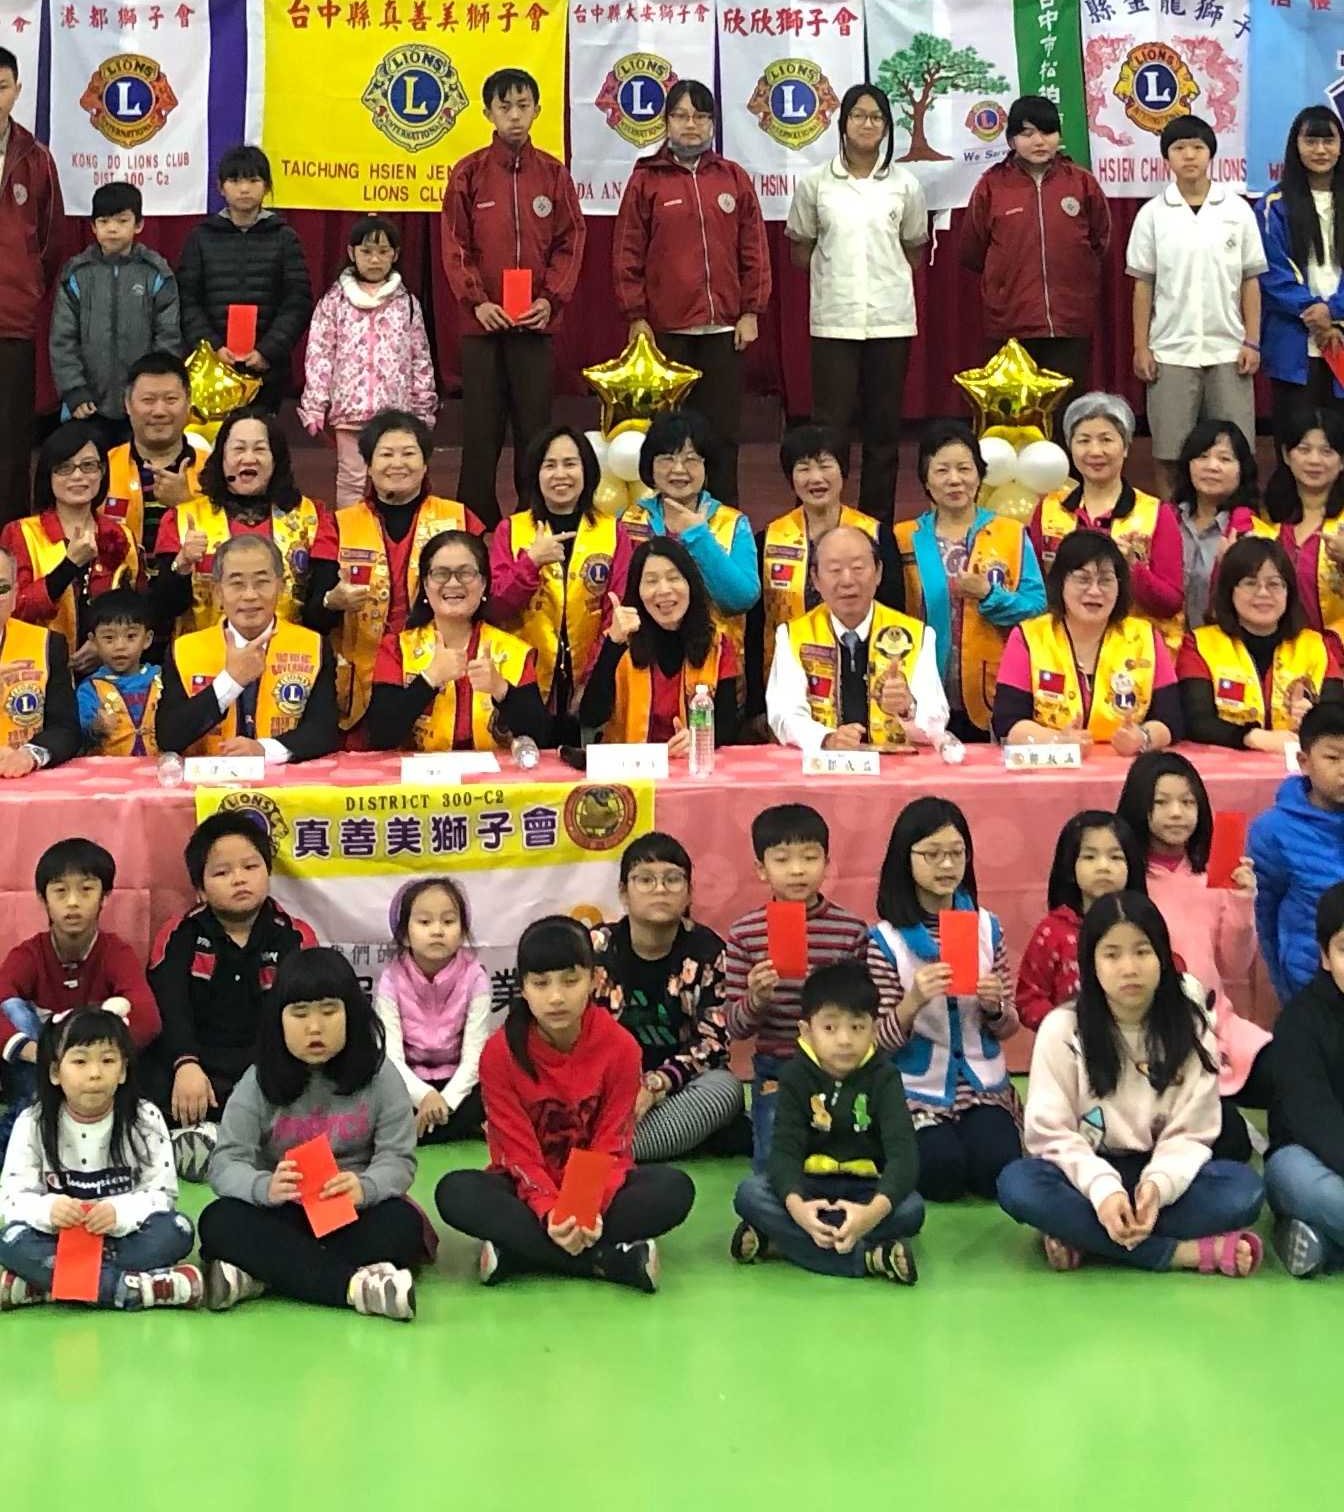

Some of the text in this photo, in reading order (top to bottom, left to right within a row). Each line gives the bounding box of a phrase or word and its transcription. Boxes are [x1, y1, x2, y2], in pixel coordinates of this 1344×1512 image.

[60, 3, 196, 32] 港都獅子會
[573, 3, 710, 24] 台中縣大安獅子會
[723, 6, 859, 37] 欣欣獅子會
[392, 51, 445, 72] LIONS
[1134, 48, 1175, 65] LIONS
[107, 60, 154, 78] LIONS
[620, 59, 667, 78] LIONS
[771, 62, 817, 80] LIONS
[403, 76, 429, 116] L
[1145, 72, 1172, 102] L
[117, 82, 143, 117] L
[631, 81, 654, 115] L
[782, 86, 806, 118] L
[72, 152, 190, 168] KONG DO LIONS CLUB
[282, 160, 359, 179] TAICHUNG
[369, 161, 417, 180] HSIEN
[1099, 158, 1135, 183] HSIEN
[363, 184, 447, 202] LIONS CLU
[761, 176, 789, 197] HSIN
[227, 793, 273, 811] LIONS
[346, 790, 505, 811] DISTRICT 300-C2
[294, 806, 558, 857] 真善美獅子會
